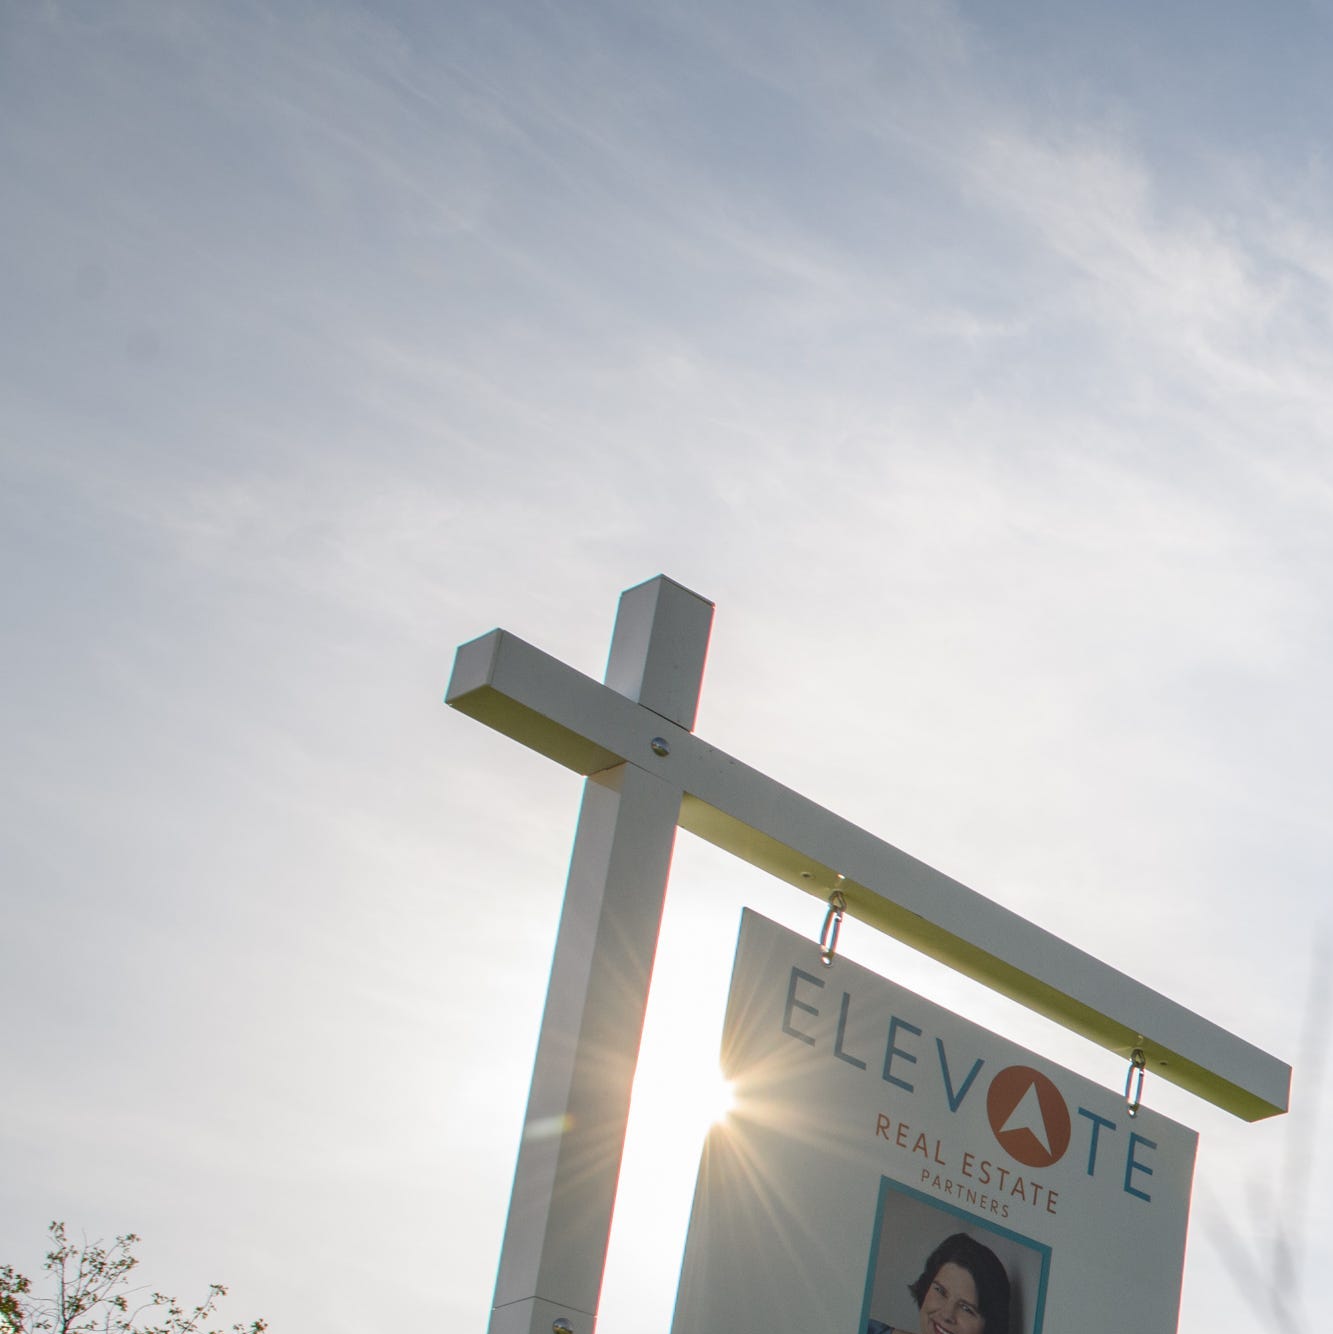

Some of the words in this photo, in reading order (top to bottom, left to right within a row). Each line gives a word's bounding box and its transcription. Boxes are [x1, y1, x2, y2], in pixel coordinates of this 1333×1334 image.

[876, 1113, 946, 1166] REAL
[962, 1152, 1058, 1215] ESTATE
[921, 1169, 1009, 1218] PARTNERS
